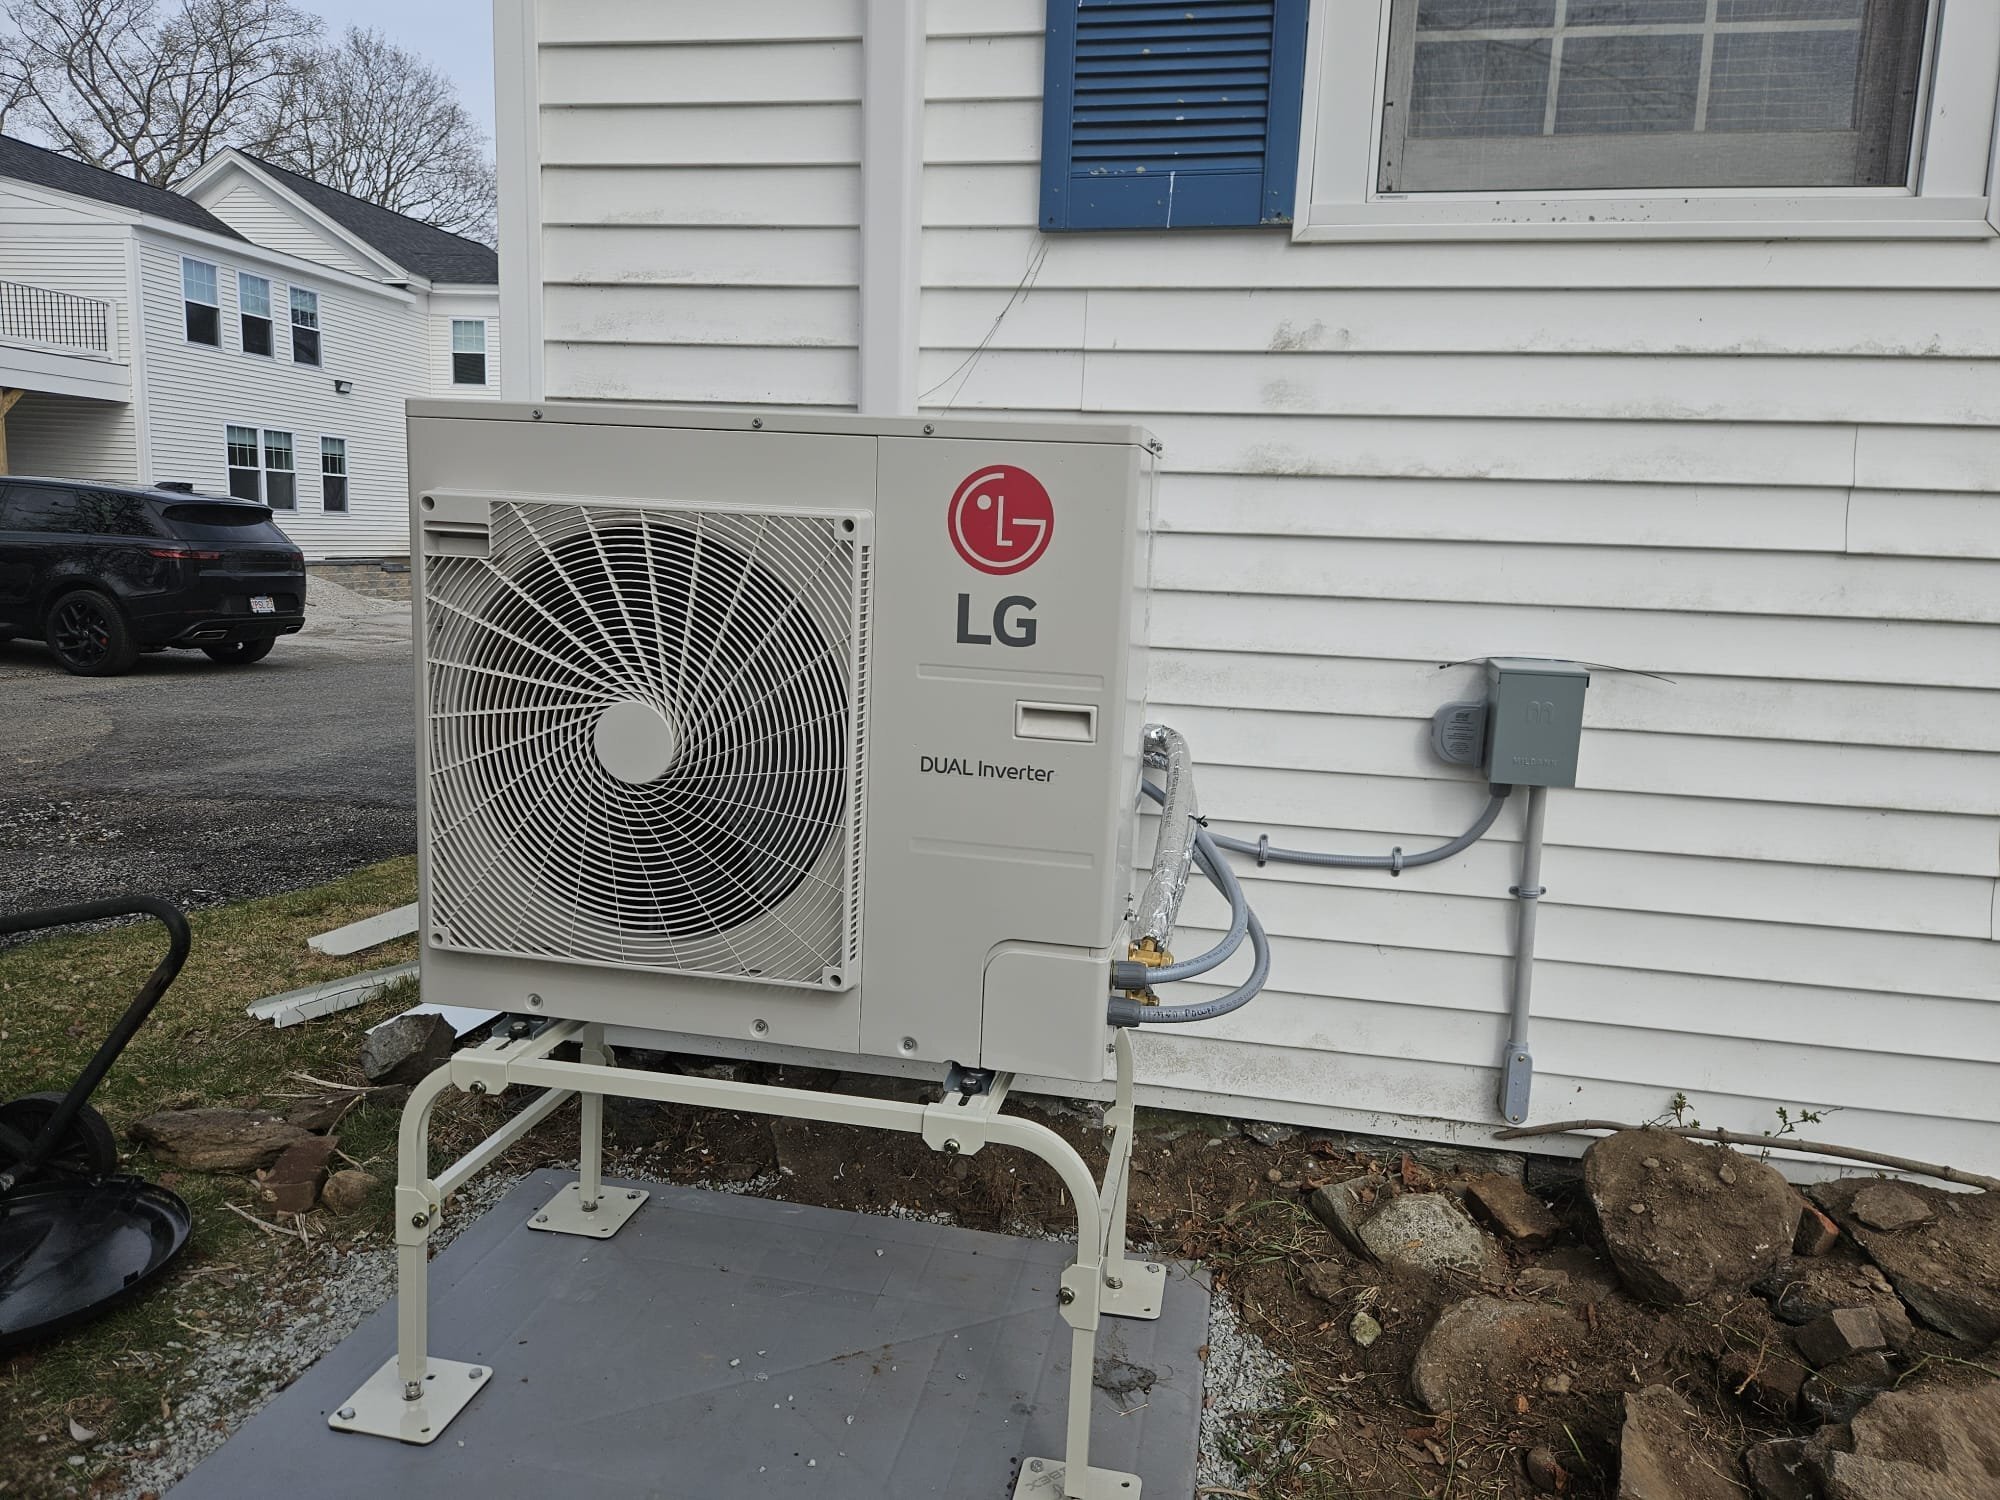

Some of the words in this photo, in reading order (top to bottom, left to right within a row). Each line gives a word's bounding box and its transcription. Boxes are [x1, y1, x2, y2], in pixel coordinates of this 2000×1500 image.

[957, 593, 1038, 648] LG
[920, 756, 974, 776] DUAL
[978, 760, 1055, 782] Inverter
